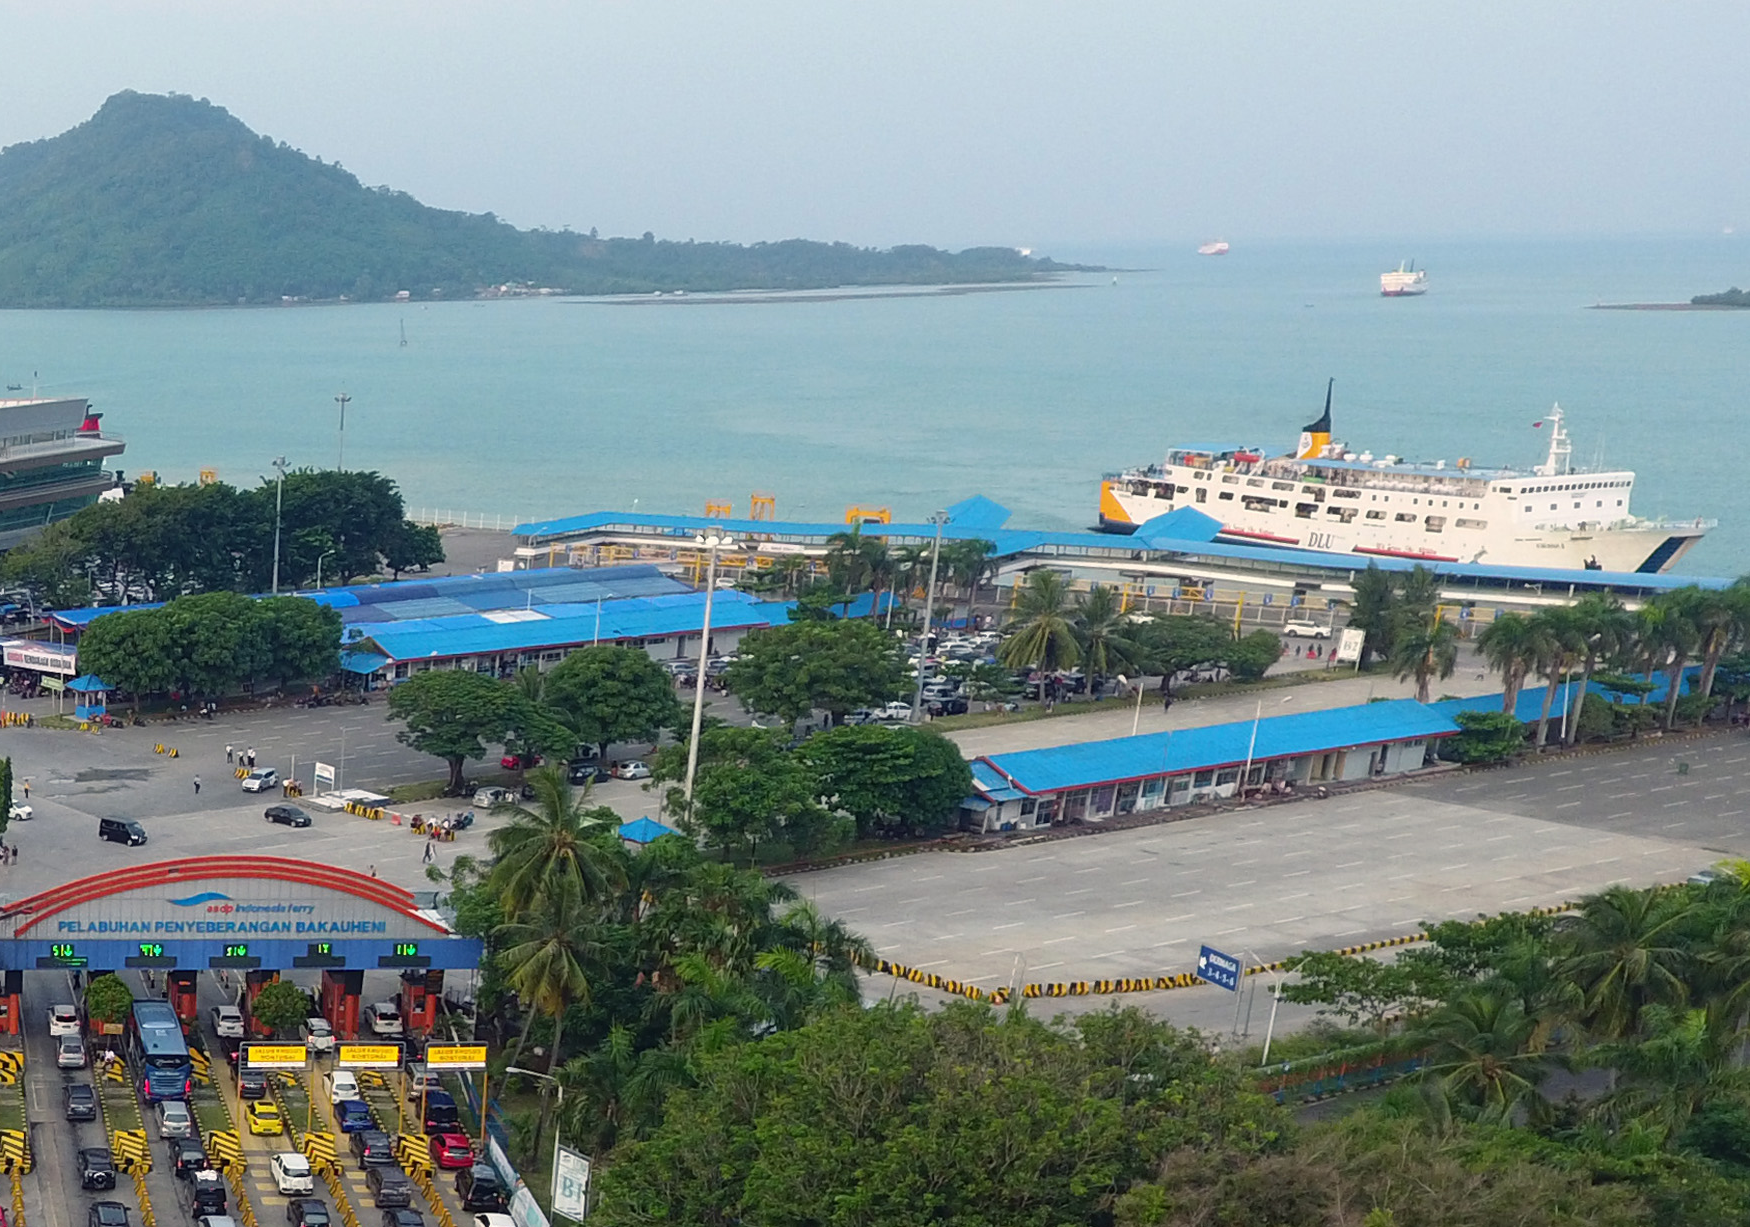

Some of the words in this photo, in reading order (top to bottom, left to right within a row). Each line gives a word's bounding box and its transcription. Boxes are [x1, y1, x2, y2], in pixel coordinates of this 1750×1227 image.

[1308, 532, 1334, 549] DLU
[58, 921, 151, 933] PELABUHAN
[155, 921, 291, 933] PENYEBERANGAN
[296, 921, 387, 933] BAKAUHENI
